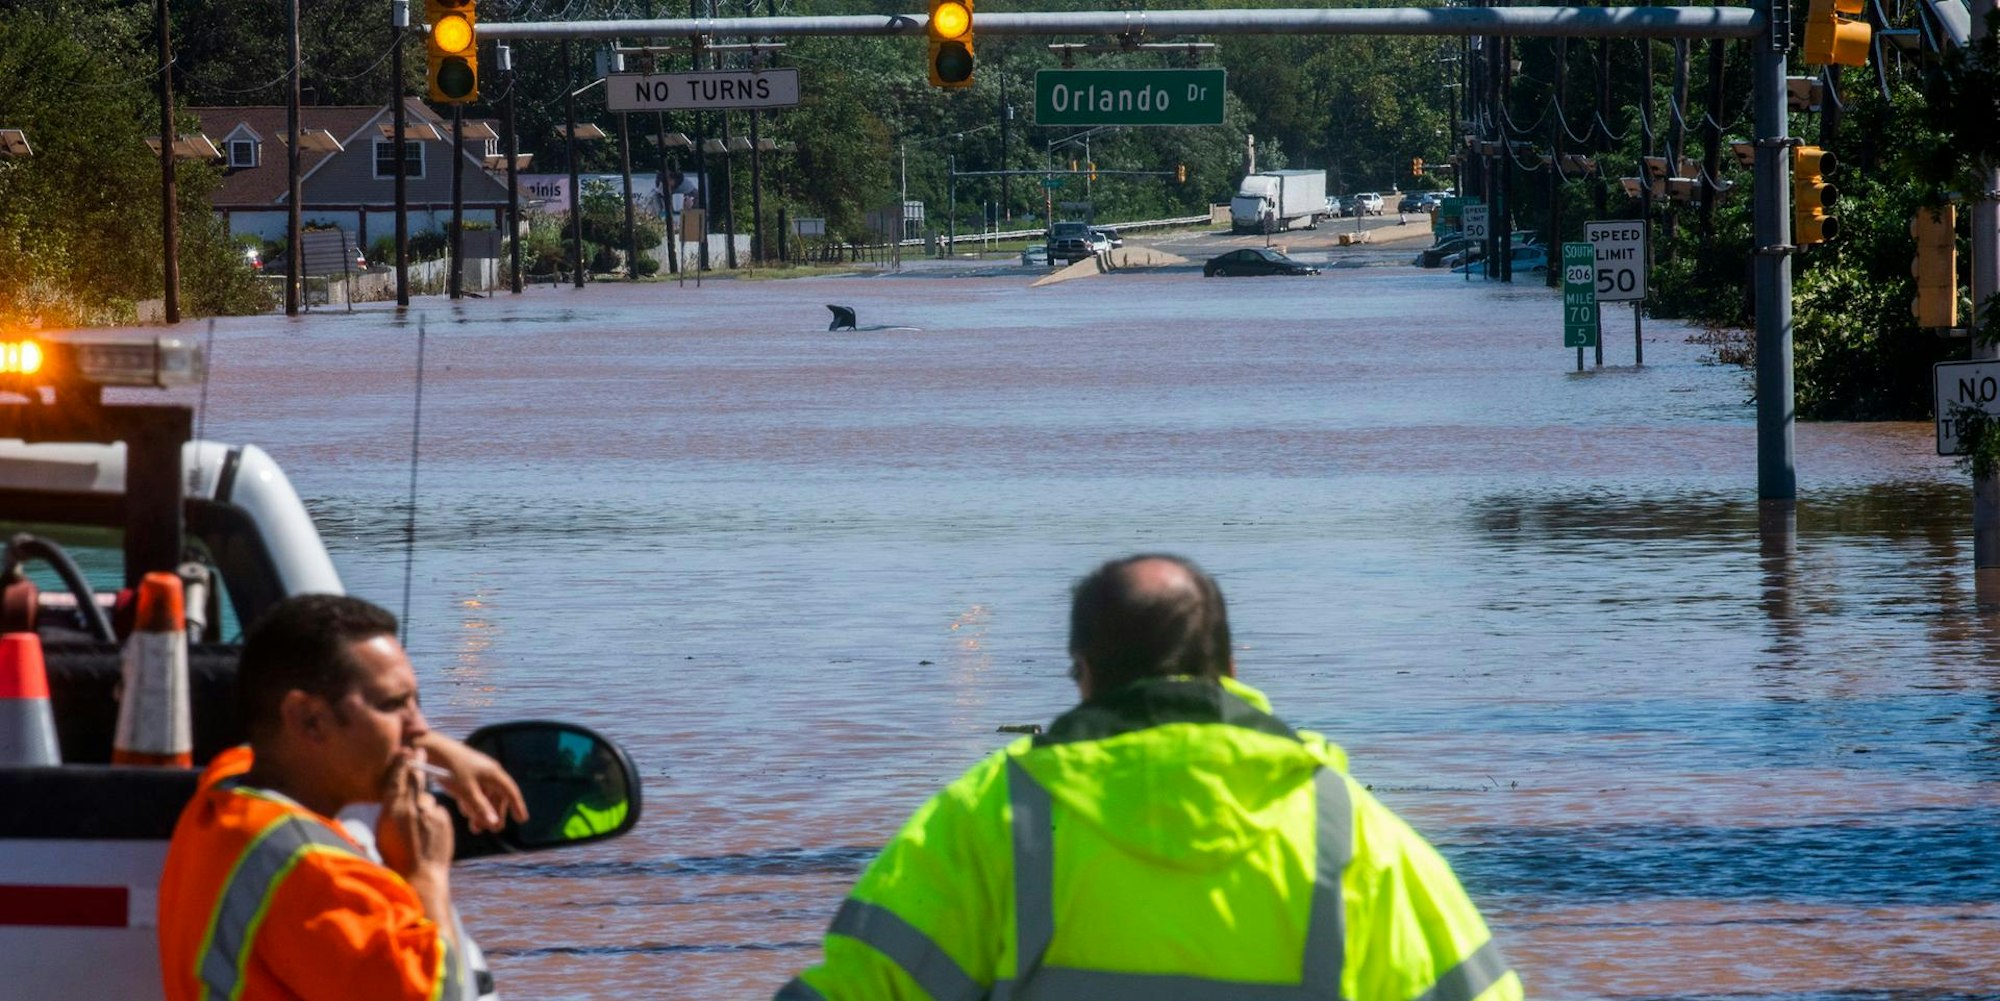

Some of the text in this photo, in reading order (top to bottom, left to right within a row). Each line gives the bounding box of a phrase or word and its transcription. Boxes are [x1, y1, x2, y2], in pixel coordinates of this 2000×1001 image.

[636, 78, 771, 102] NO TURNS
[1051, 83, 1207, 112] Orlando Dr
[1467, 225, 1484, 236] 50
[1591, 230, 1640, 242] SPEED
[1565, 245, 1593, 258] SOUTH
[1596, 248, 1635, 261] LIMIT
[1568, 269, 1591, 280] 206
[1597, 269, 1635, 293] 50
[1566, 293, 1593, 305] MILE
[1570, 307, 1590, 322] 70
[1959, 376, 1997, 403] NO
